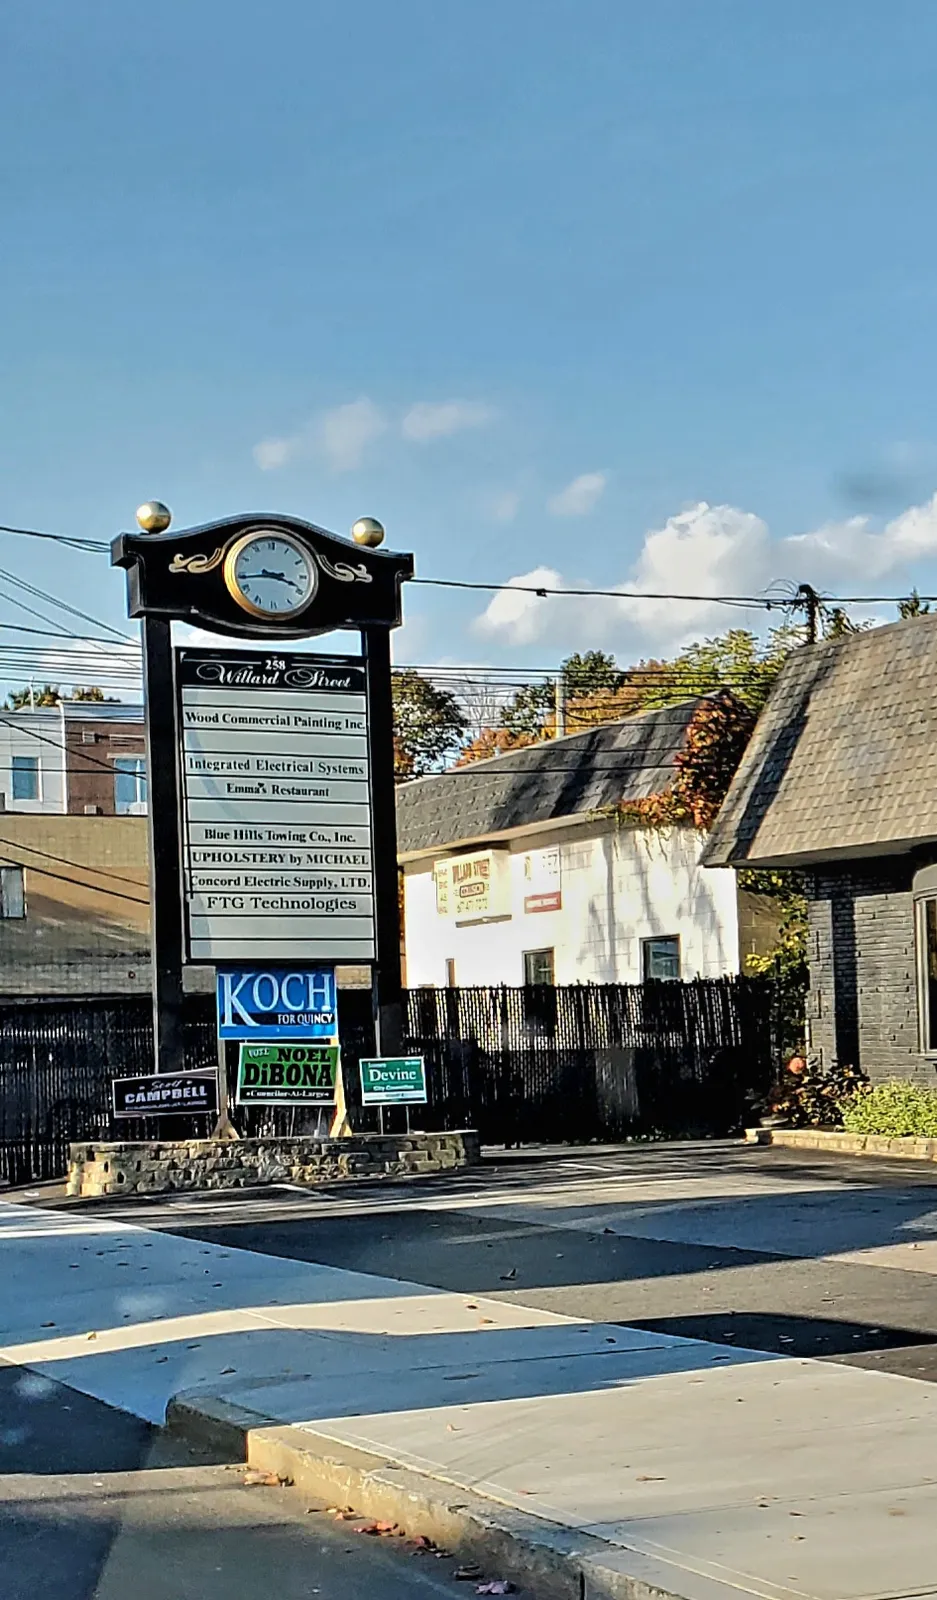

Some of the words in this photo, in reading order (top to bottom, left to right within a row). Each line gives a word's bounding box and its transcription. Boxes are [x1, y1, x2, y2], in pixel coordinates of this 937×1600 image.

[265, 659, 286, 671] 258
[196, 663, 280, 685] Willard
[284, 667, 351, 688] Street
[185, 711, 219, 723] Wood
[222, 713, 290, 726] Commercial
[294, 716, 342, 730] Painting
[345, 719, 366, 730] Inc.
[189, 757, 250, 771] Integrated
[256, 759, 314, 773] Electrical
[318, 761, 364, 775] Systems
[226, 782, 267, 794] Emma's
[271, 784, 329, 797] Restaurant
[204, 829, 230, 840] Blue
[233, 829, 263, 841] Hills
[265, 829, 307, 843] Towing
[309, 831, 331, 843] Co.,
[334, 832, 356, 842] Inc.
[192, 852, 285, 863] UPHOLSTERY
[289, 852, 301, 866] by
[306, 853, 369, 865] MICHAEL
[190, 875, 241, 887] Concord
[244, 876, 291, 887] Electric
[293, 876, 338, 890] Supply,
[341, 877, 371, 888] LTD.
[207, 897, 244, 909] FTG
[250, 897, 357, 912] Technologies
[218, 973, 331, 1027] KOCH
[277, 1014, 296, 1024] FOR
[297, 1013, 333, 1026] QUINCY
[277, 1048, 331, 1062] NOEL
[243, 1063, 333, 1087] DiBONA
[369, 1068, 416, 1082] Devine
[151, 1079, 183, 1091] Scott
[124, 1085, 207, 1104] CAMPBELL
